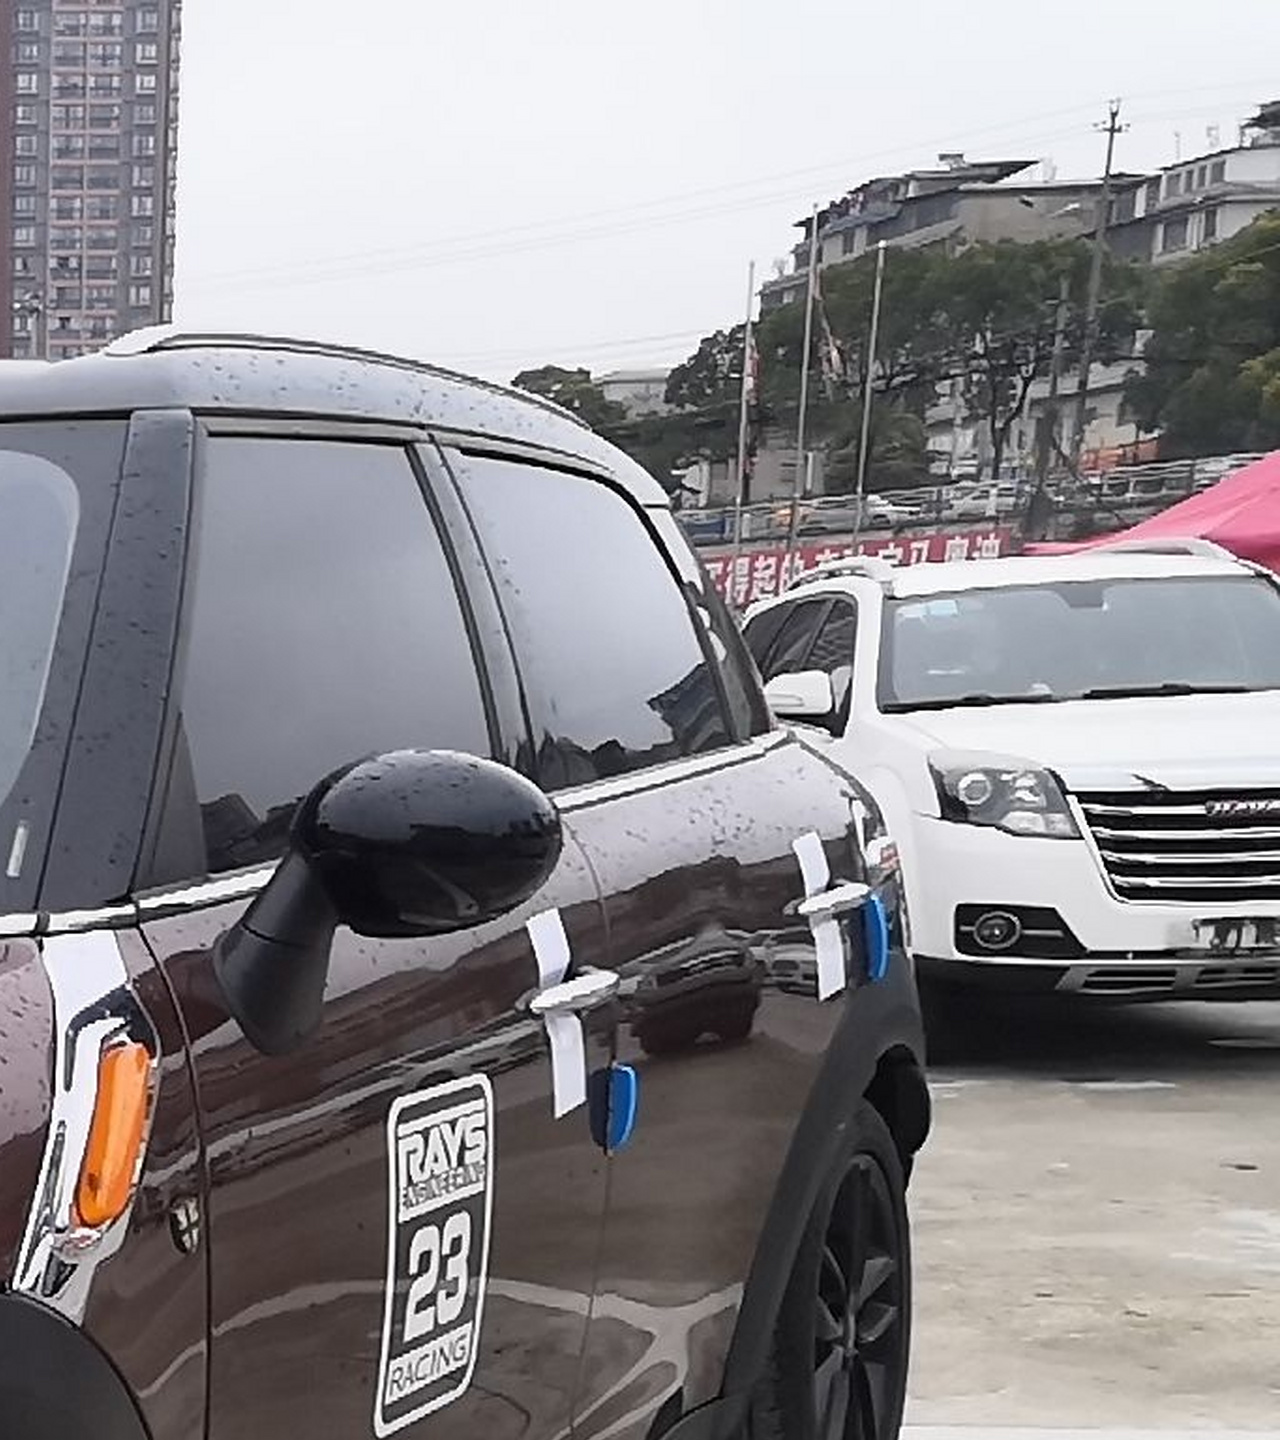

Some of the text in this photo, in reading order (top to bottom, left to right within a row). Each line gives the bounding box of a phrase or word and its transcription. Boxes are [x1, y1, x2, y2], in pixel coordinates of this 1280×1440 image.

[398, 1111, 485, 1184] RAYS
[403, 1210, 472, 1343] 23
[389, 1339, 468, 1393] RACING
